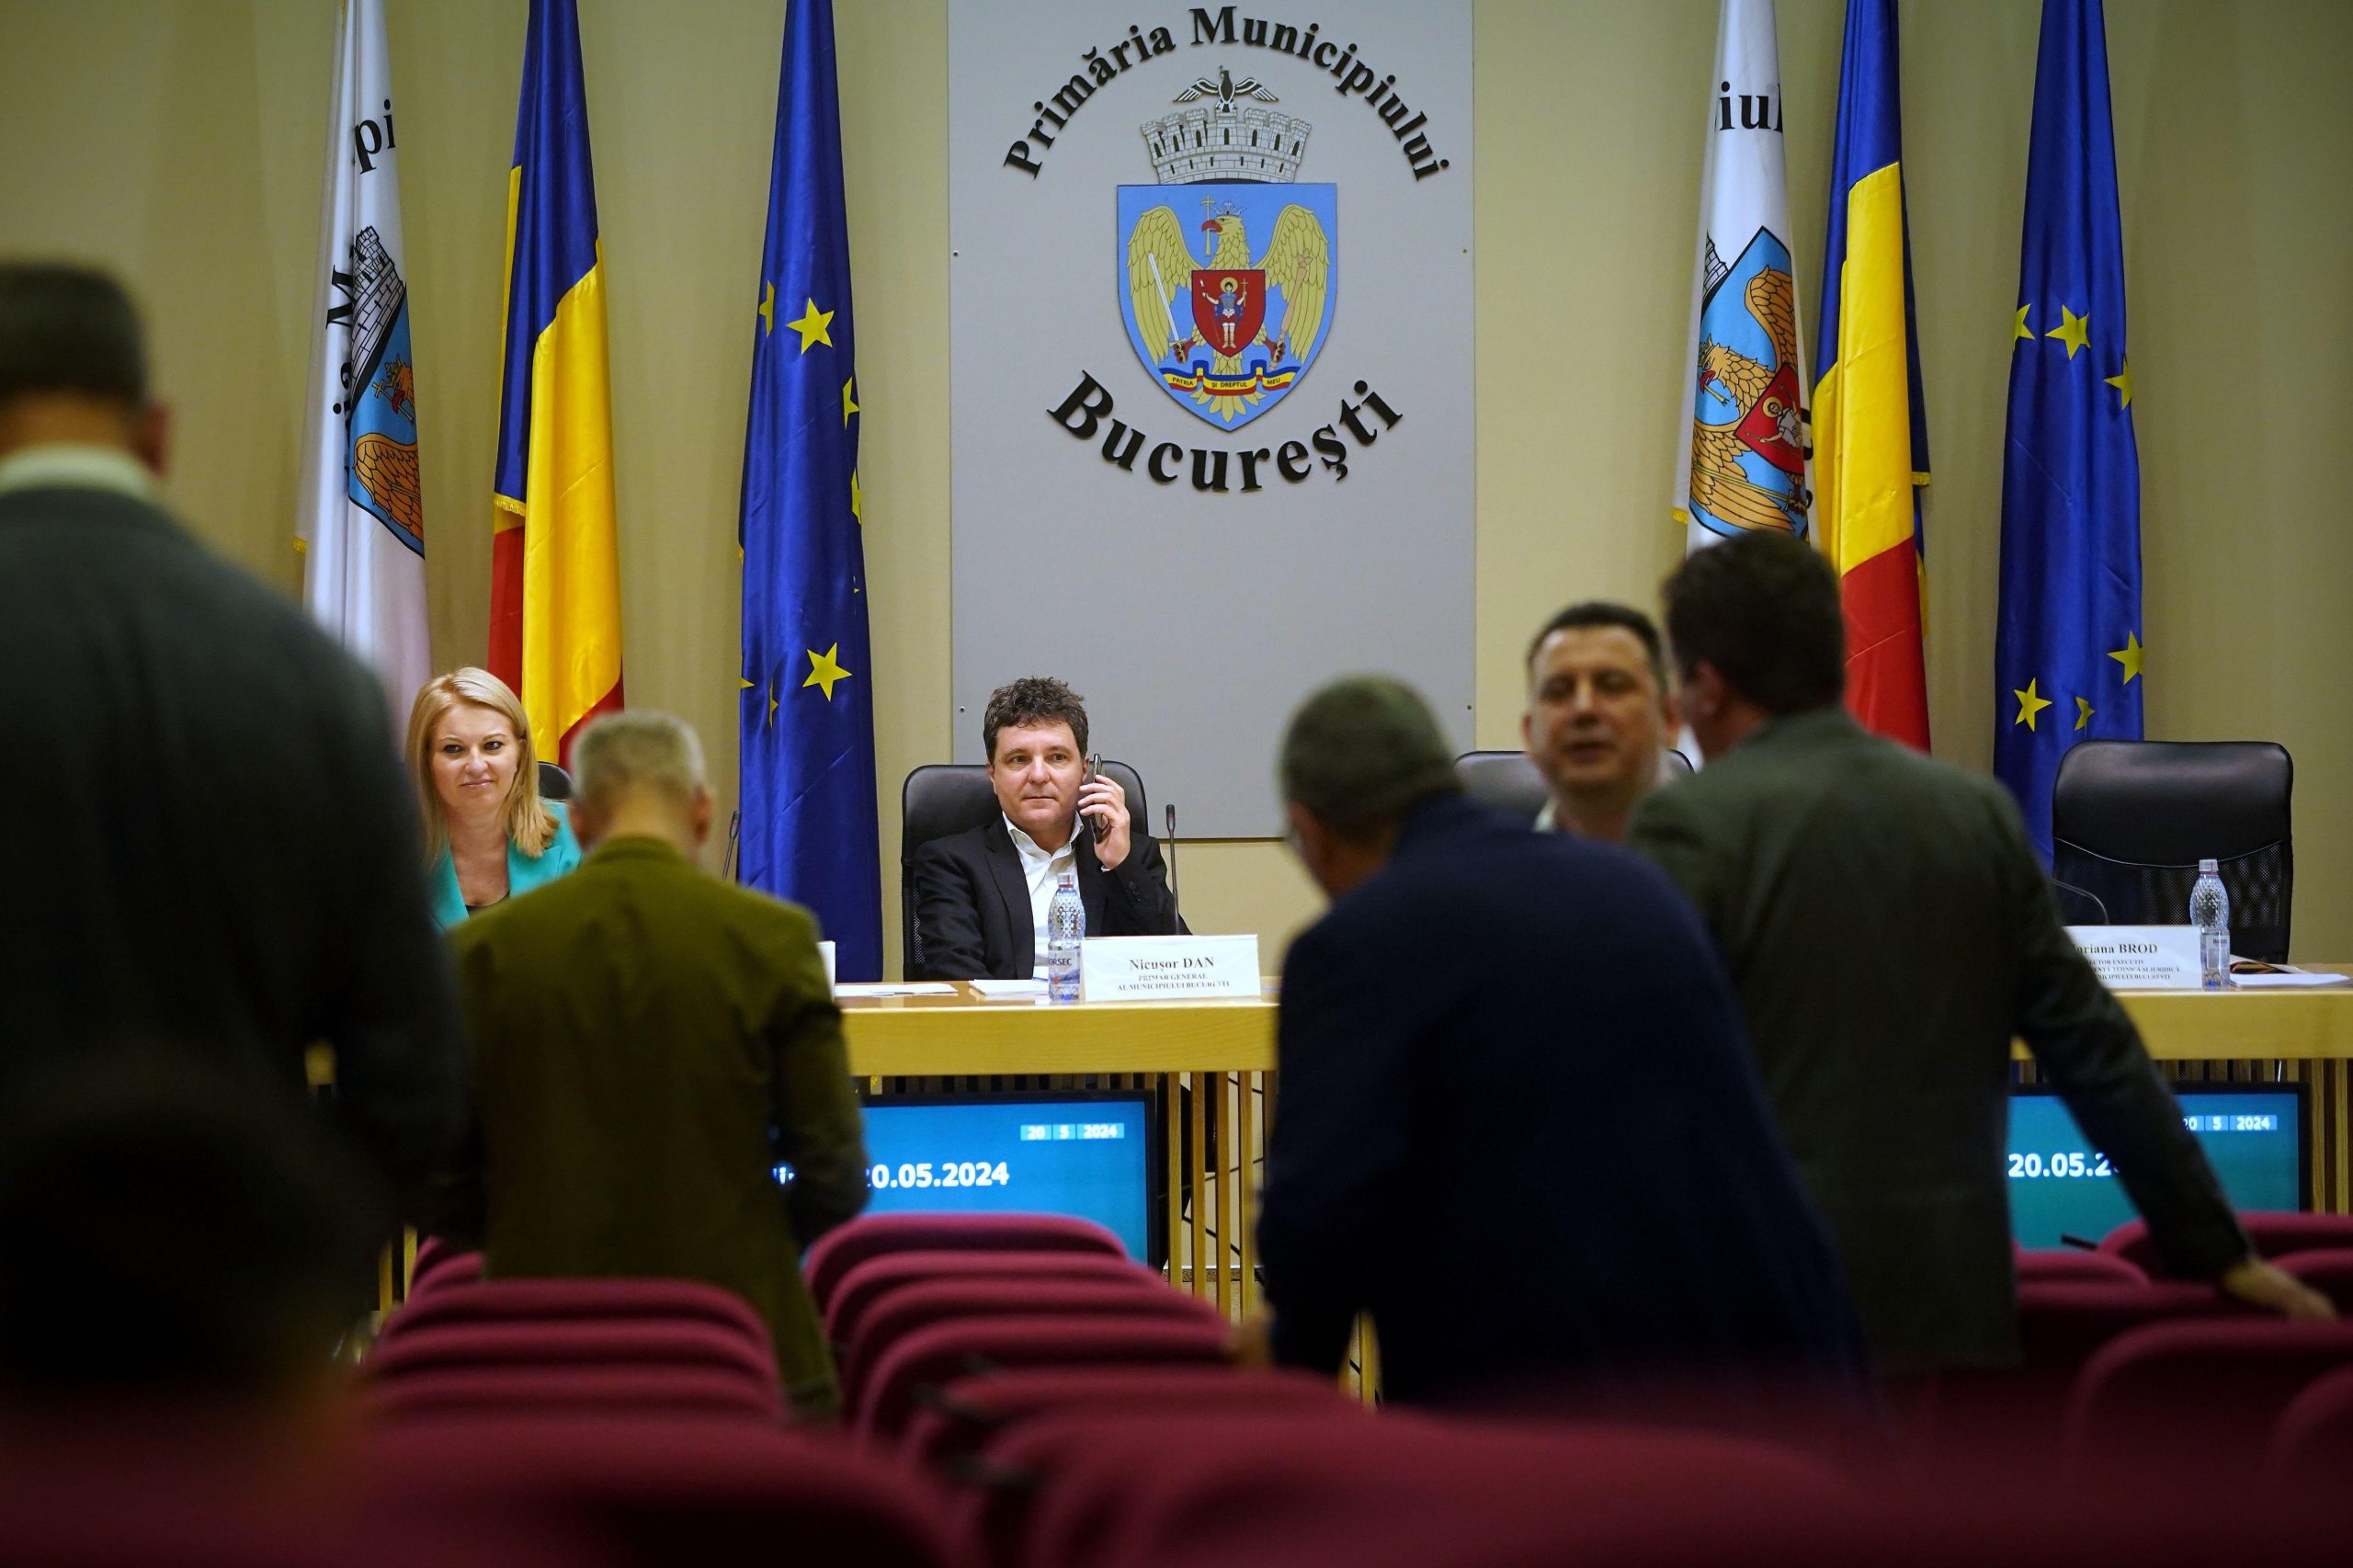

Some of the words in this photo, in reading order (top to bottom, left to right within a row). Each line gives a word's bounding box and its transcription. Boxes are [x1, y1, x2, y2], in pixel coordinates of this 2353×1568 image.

[1003, 24, 1176, 181] Primăria
[1188, 6, 1450, 182] Municipiului
[1172, 376, 1194, 386] PATRIA
[1046, 369, 1404, 494] București
[2072, 944, 2115, 954] ariana
[2119, 943, 2158, 954] BROD
[1048, 958, 1072, 966] ORSEC
[1129, 959, 1179, 971] Nicușor
[1183, 956, 1214, 969] DAN
[1170, 972, 1207, 981] GENERAL
[1130, 982, 1185, 991] MUNICIPIULUI
[2212, 1117, 2222, 1130] 5
[2236, 1117, 2270, 1131] 2024
[1027, 1126, 1045, 1139] 20
[1059, 1126, 1069, 1139] 5
[1083, 1124, 1118, 1139] 2024
[2007, 1153, 2119, 1177] 20.05.2
[865, 1162, 1010, 1188] 0.05.2024
